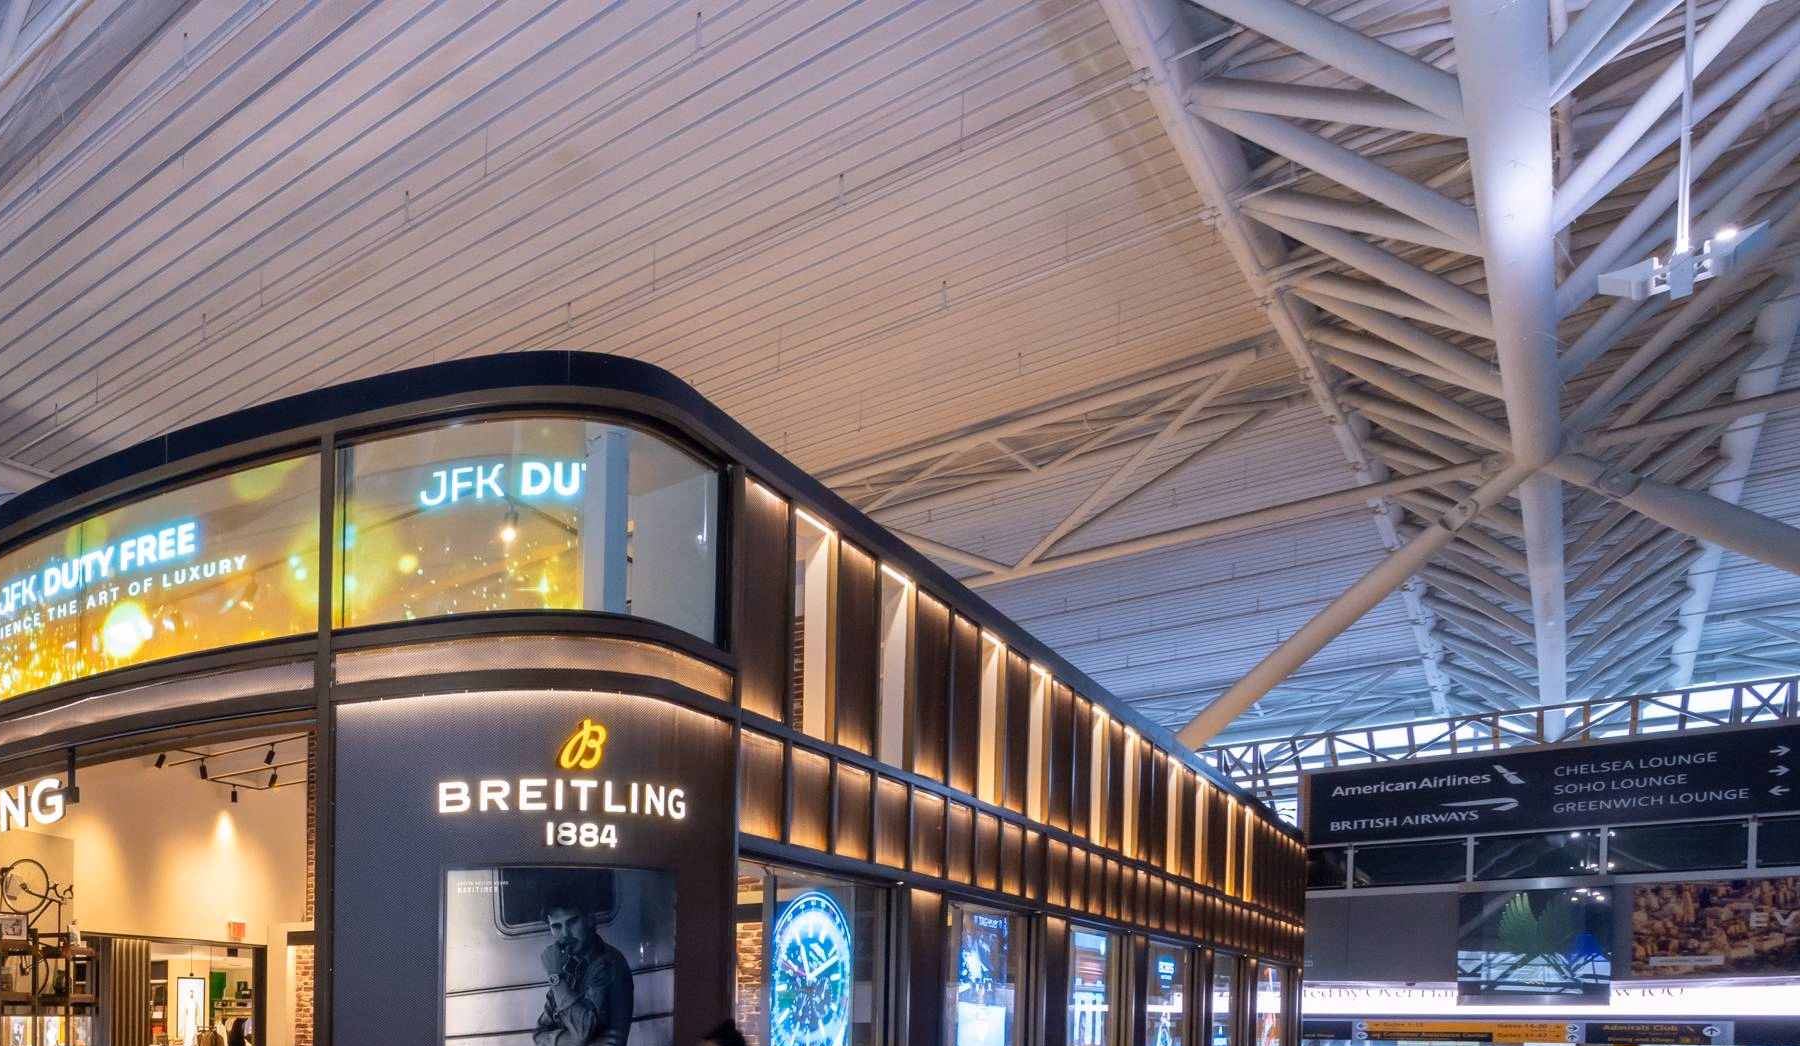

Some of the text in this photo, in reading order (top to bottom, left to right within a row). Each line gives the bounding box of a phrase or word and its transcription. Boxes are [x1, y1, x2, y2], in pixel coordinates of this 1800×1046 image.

[420, 462, 586, 506] JFK DU
[43, 546, 116, 597] DUTY
[120, 523, 196, 571] FREE
[48, 602, 77, 621] THE
[86, 586, 120, 609] ART
[128, 577, 153, 597] OF
[162, 555, 248, 588] LUXURY
[1554, 751, 1718, 777] CHELSEA LOUNGE
[1332, 773, 1491, 797] American Airlines
[1553, 774, 1688, 795] SOHO LOUNGE
[439, 778, 686, 819] BREITLING
[1552, 787, 1750, 813] GREENWICH LOUNGE
[1330, 810, 1480, 832] BRITISH AIRWAYS
[546, 822, 618, 847] 1884
[1603, 1024, 1678, 1032] Admirals Club
